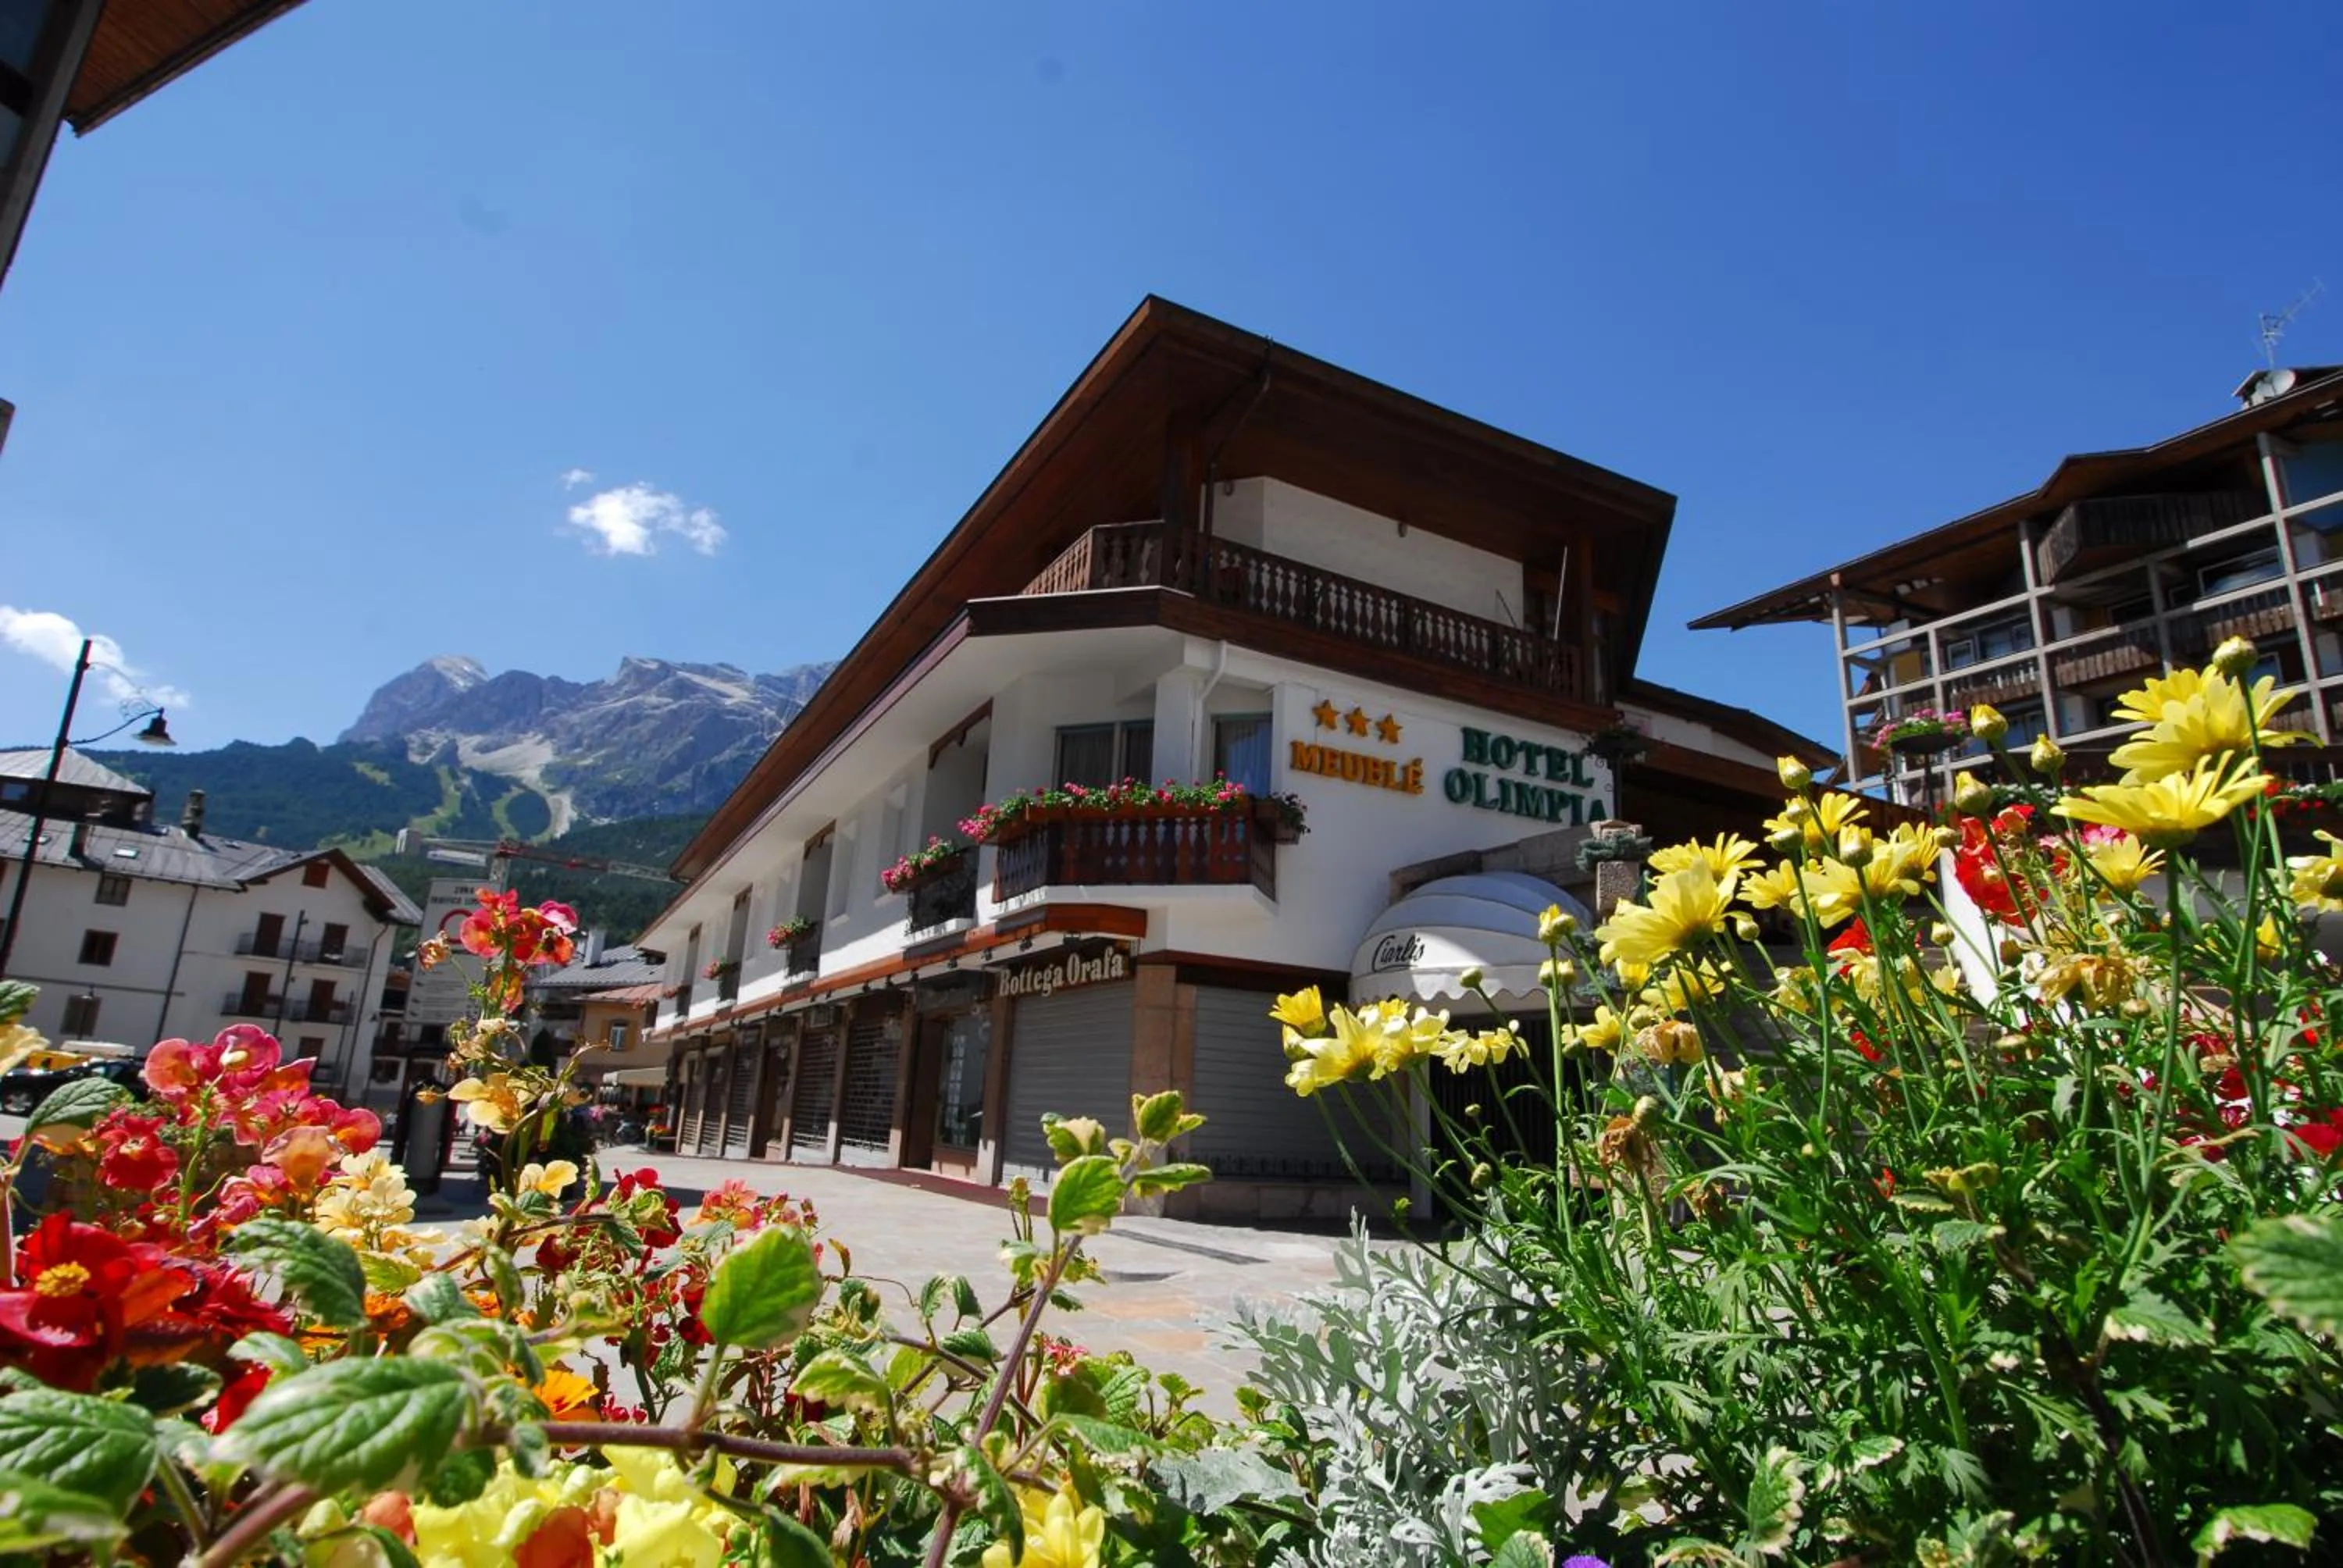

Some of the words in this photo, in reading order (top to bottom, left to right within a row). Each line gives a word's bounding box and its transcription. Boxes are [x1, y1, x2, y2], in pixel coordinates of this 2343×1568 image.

[1289, 740, 1425, 794] MEUBLÉ
[1462, 726, 1595, 788] HOTEL
[1445, 767, 1607, 827] OLIMPIA
[999, 964, 1064, 997] Bottega
[1066, 946, 1124, 985] Orafa
